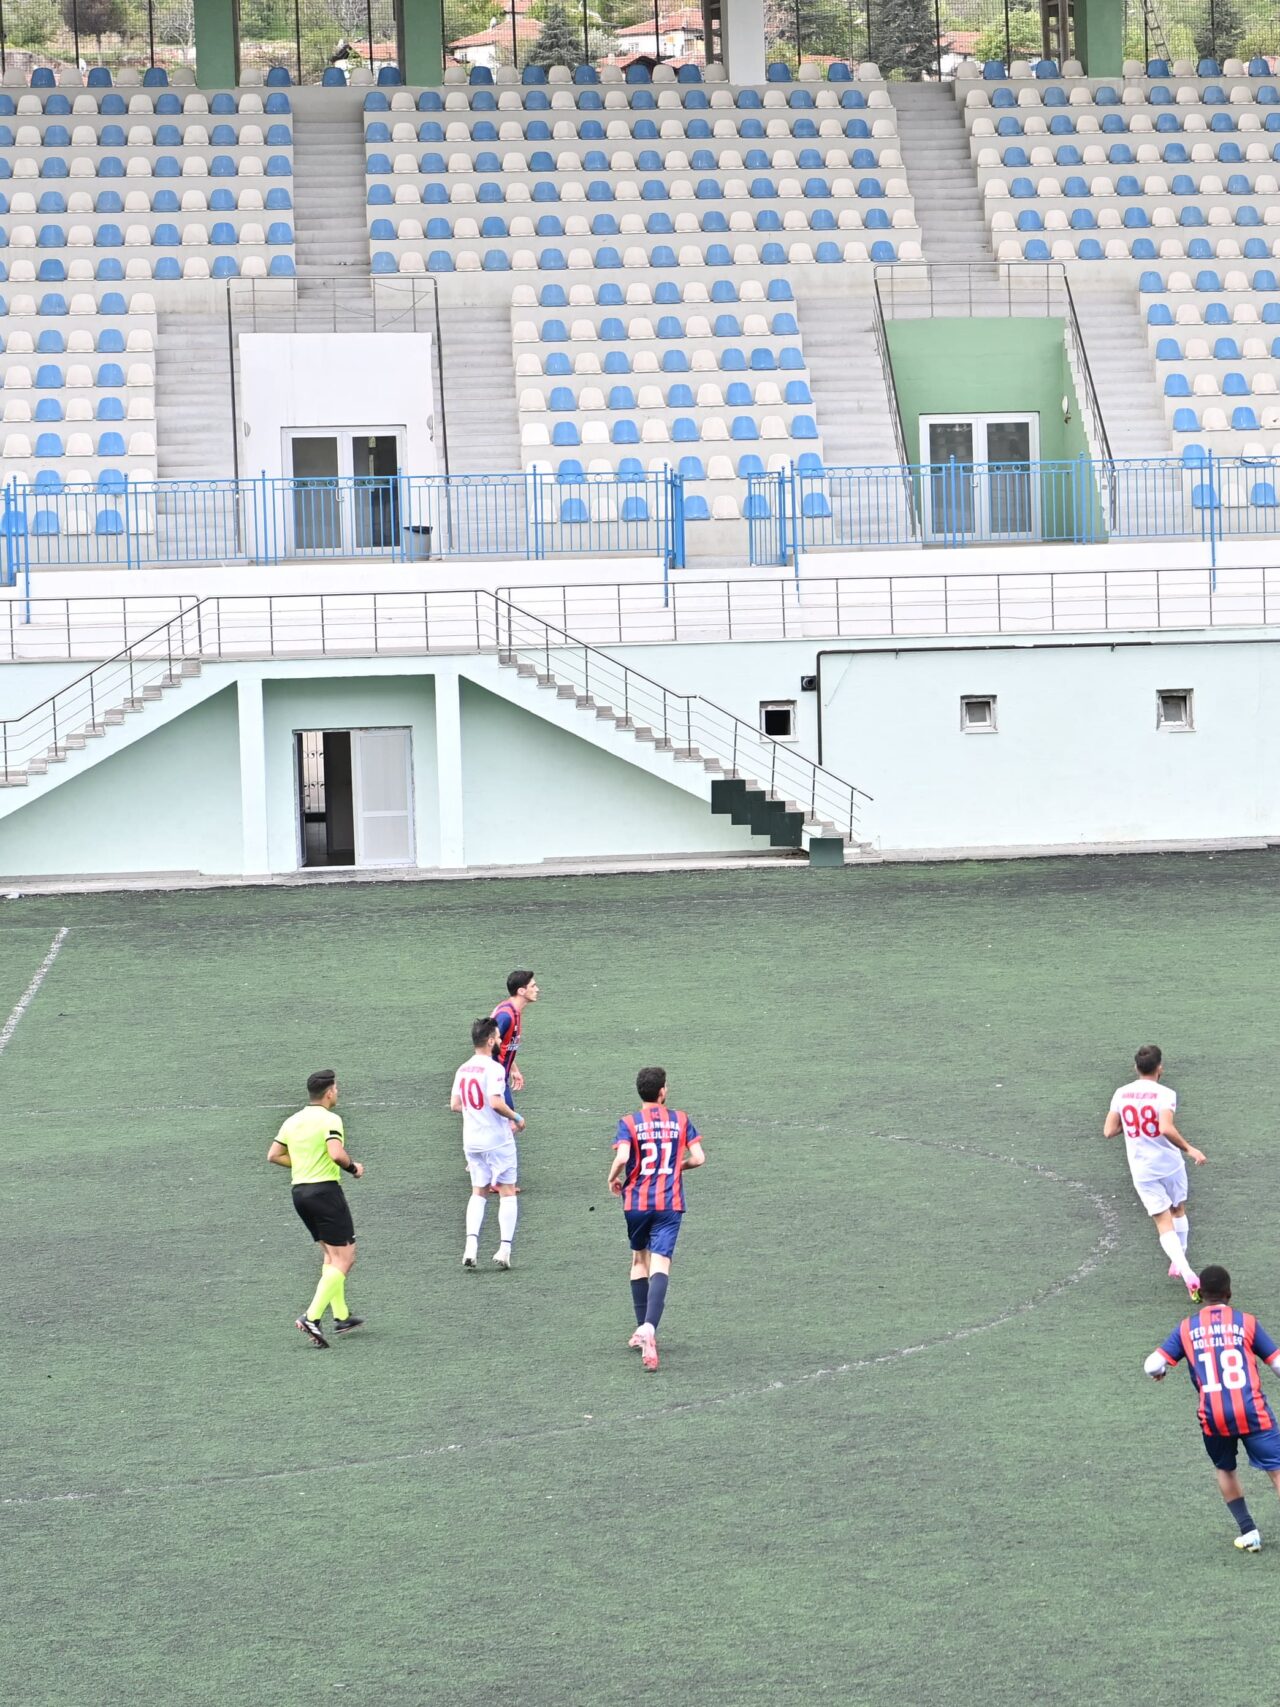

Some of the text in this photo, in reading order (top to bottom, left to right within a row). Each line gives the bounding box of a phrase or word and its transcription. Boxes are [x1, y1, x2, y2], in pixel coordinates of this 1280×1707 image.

[460, 1078, 484, 1110] 10
[1122, 1104, 1160, 1138] 98
[640, 1141, 673, 1175] 21
[1189, 1324, 1245, 1340] TED ANKARA
[1198, 1348, 1247, 1393] 18
